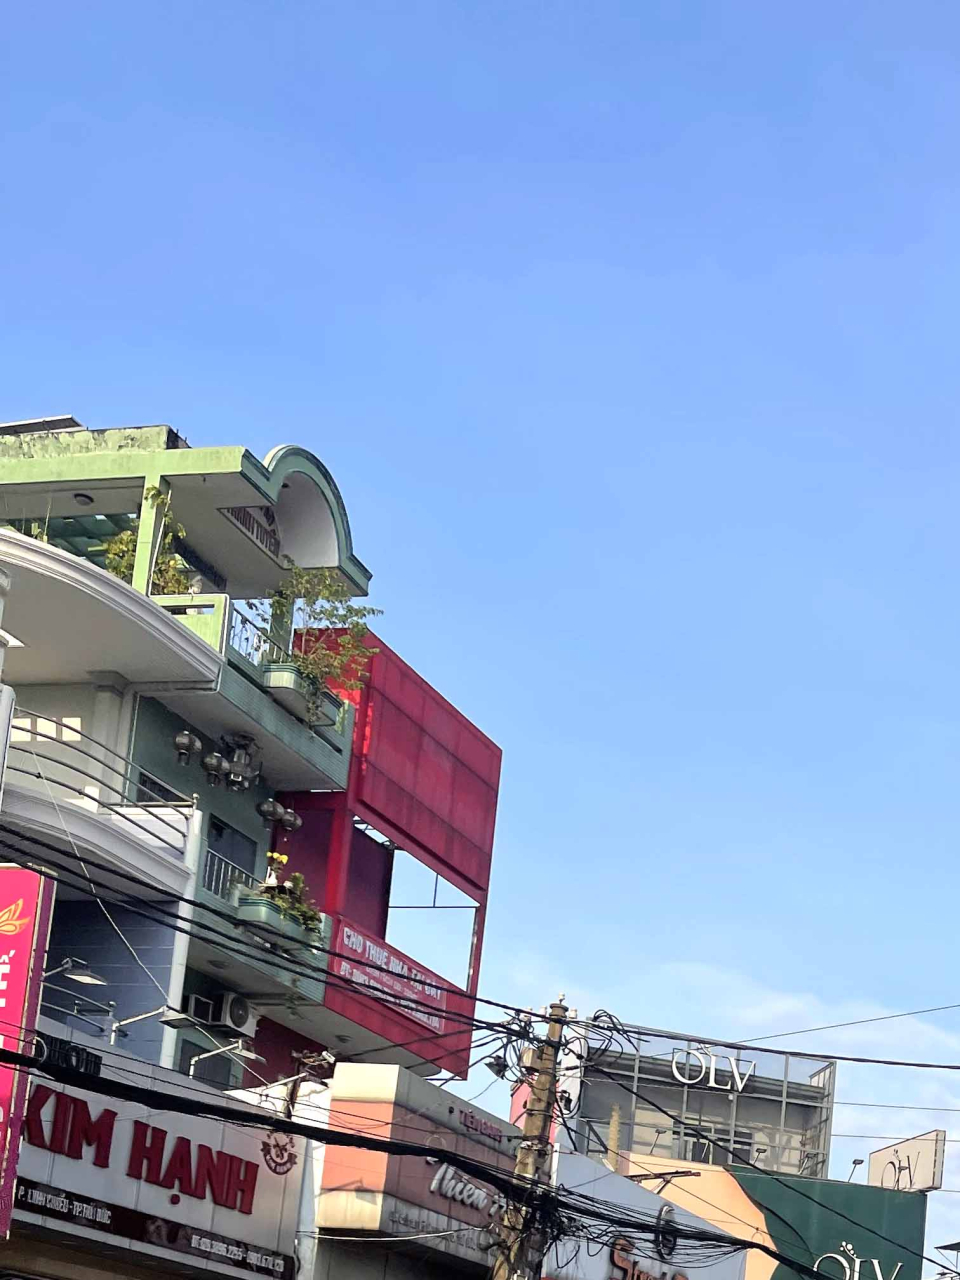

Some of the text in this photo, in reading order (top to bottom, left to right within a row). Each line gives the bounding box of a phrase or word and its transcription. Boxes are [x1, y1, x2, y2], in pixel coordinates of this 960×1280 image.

[672, 1045, 756, 1092] OLV
[24, 1084, 118, 1168] KIM
[126, 1119, 259, 1214] HẠNH
